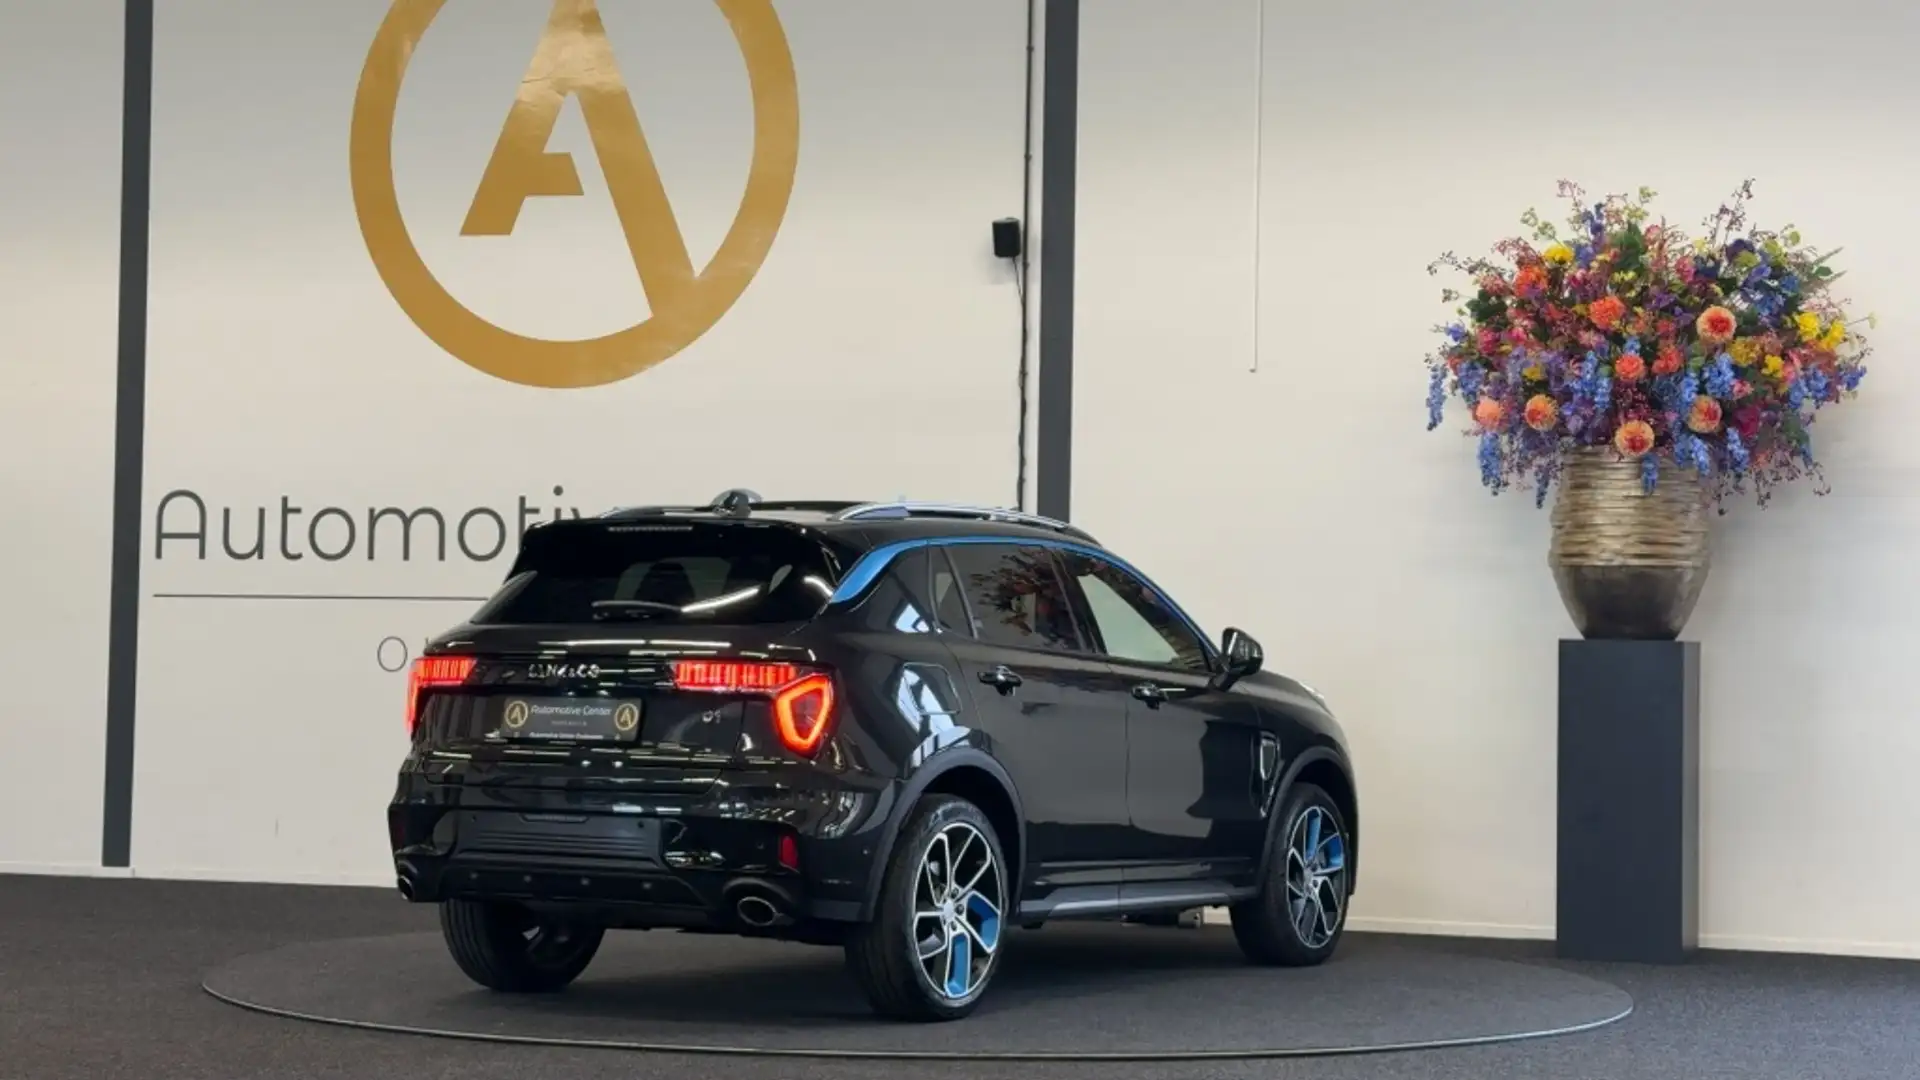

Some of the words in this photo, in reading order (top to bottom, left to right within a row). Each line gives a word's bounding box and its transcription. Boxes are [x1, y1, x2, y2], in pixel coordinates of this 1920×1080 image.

[155, 485, 580, 561] Automoti
[530, 704, 581, 716] Automotive
[583, 705, 612, 717] Center
